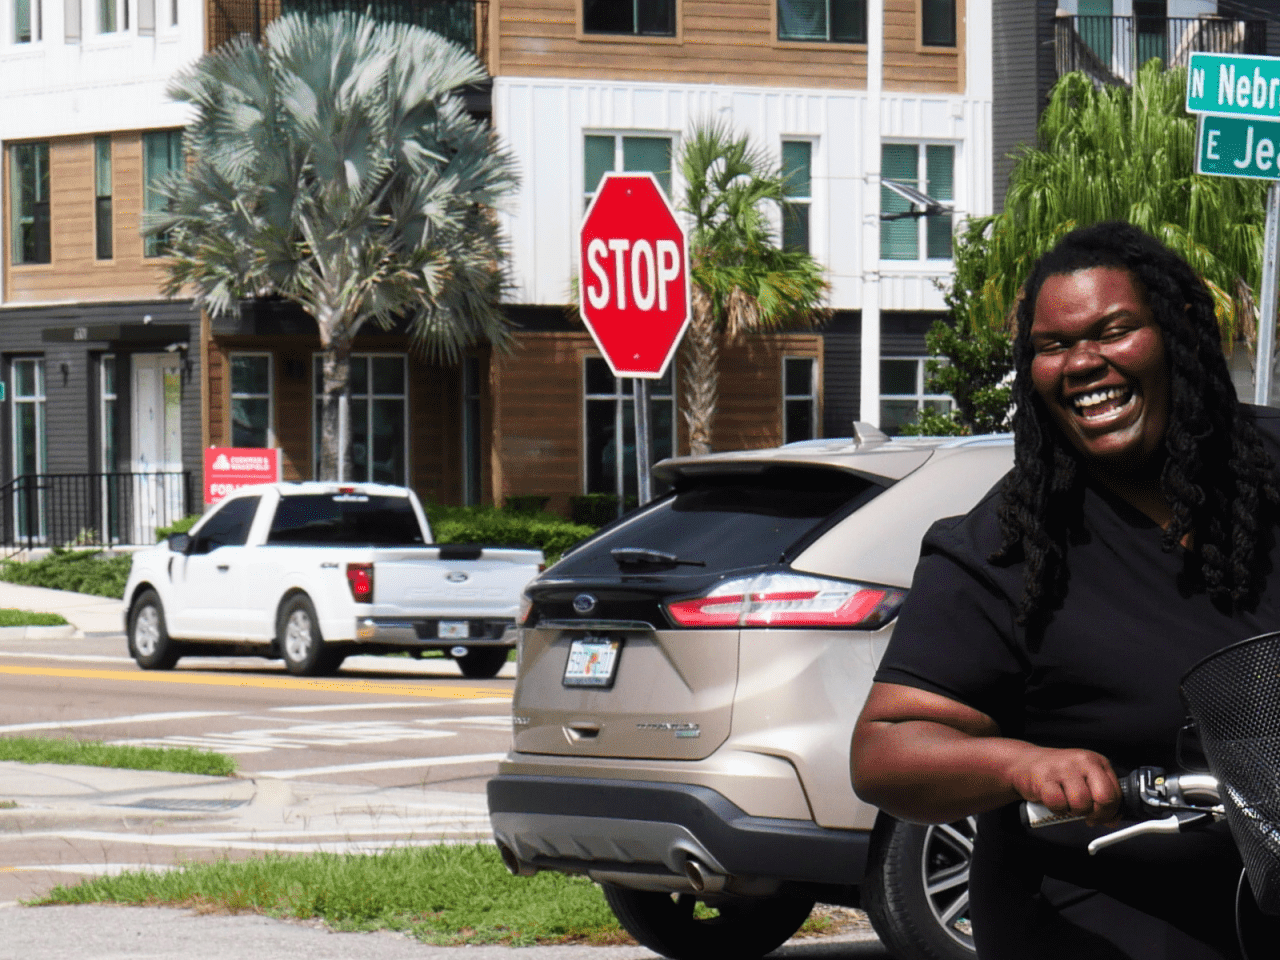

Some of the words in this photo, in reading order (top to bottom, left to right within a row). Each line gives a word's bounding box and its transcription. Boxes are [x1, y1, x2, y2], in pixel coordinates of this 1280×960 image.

[1191, 68, 1205, 98] N
[1206, 129, 1221, 160] E
[587, 238, 681, 311] STOP
